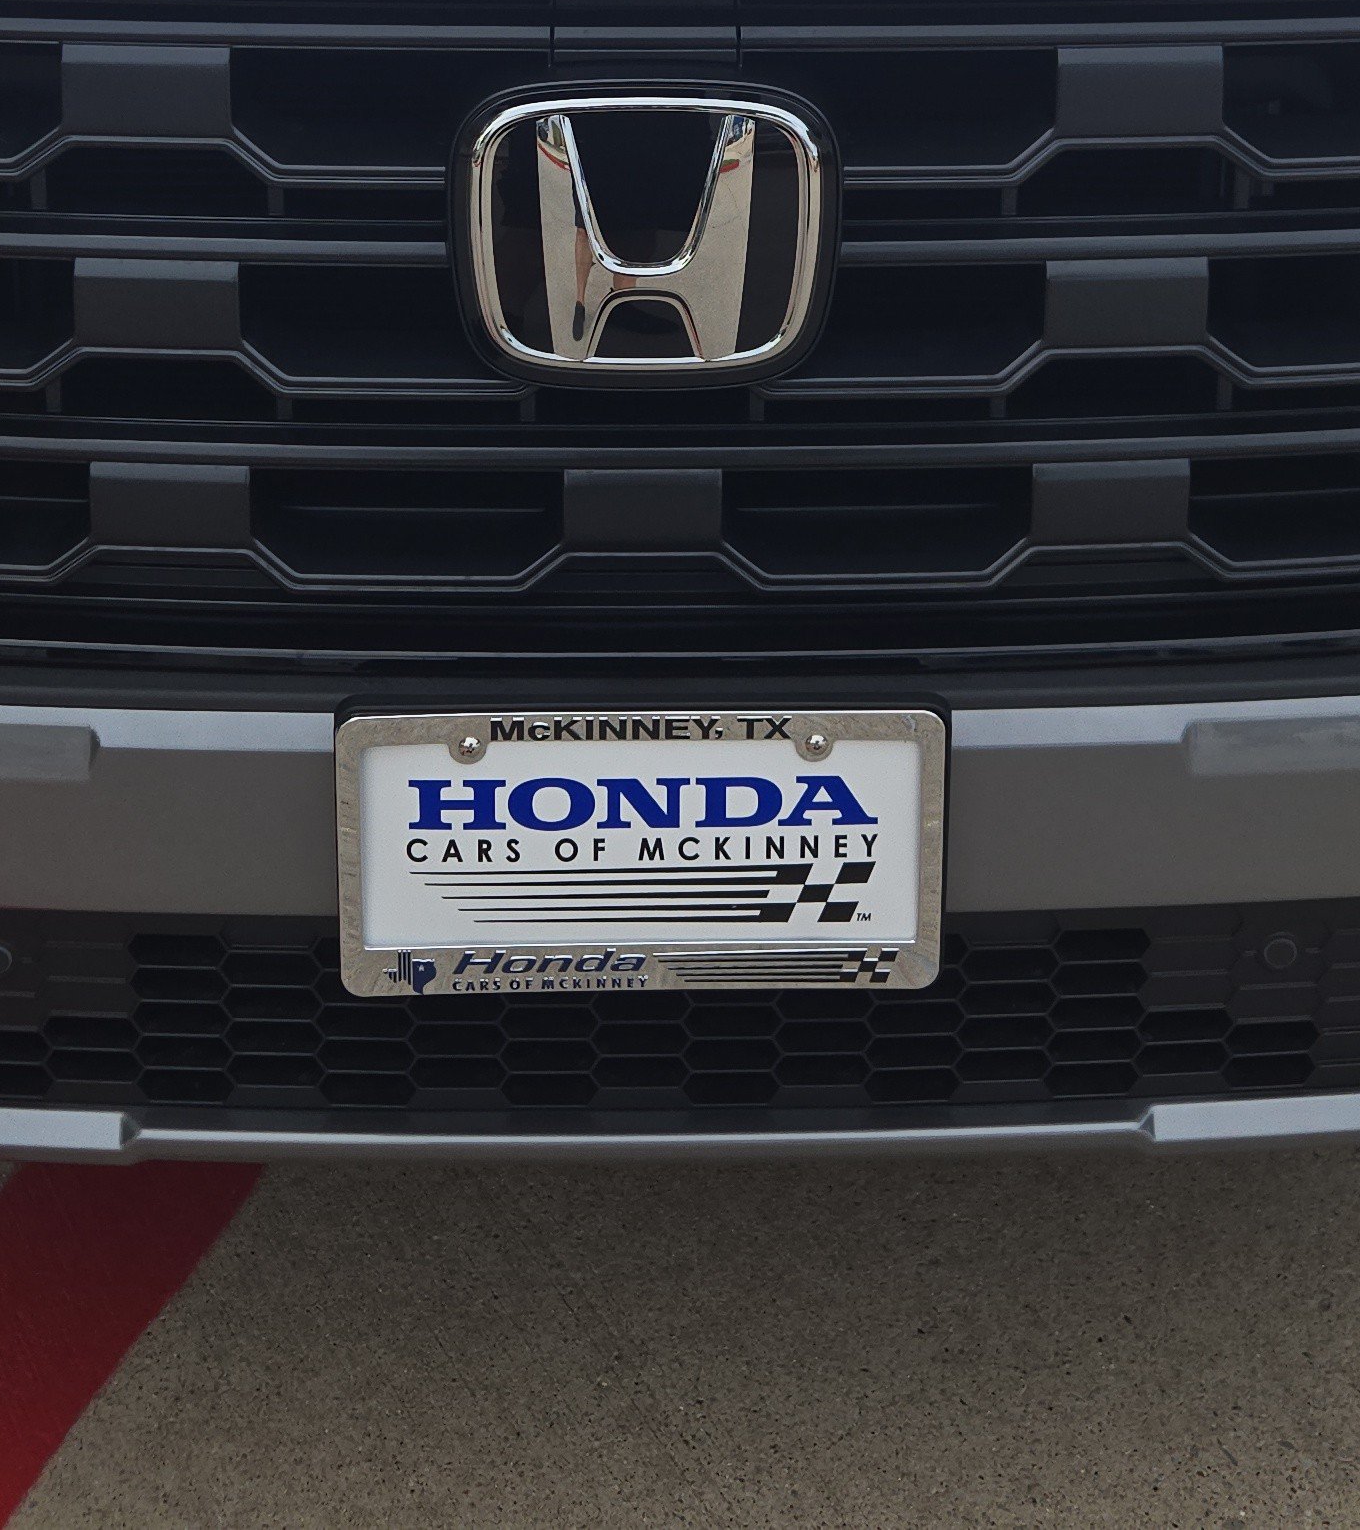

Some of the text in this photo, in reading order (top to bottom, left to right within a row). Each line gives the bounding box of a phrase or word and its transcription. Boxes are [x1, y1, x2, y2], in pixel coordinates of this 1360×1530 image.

[737, 715, 793, 740] TX
[407, 775, 879, 832] HONDA
[406, 833, 879, 863] CARS OF MCKINNEY
[856, 912, 872, 922] TM
[452, 947, 647, 975] Honda
[452, 973, 650, 992] CARS OF MCKINNEY
